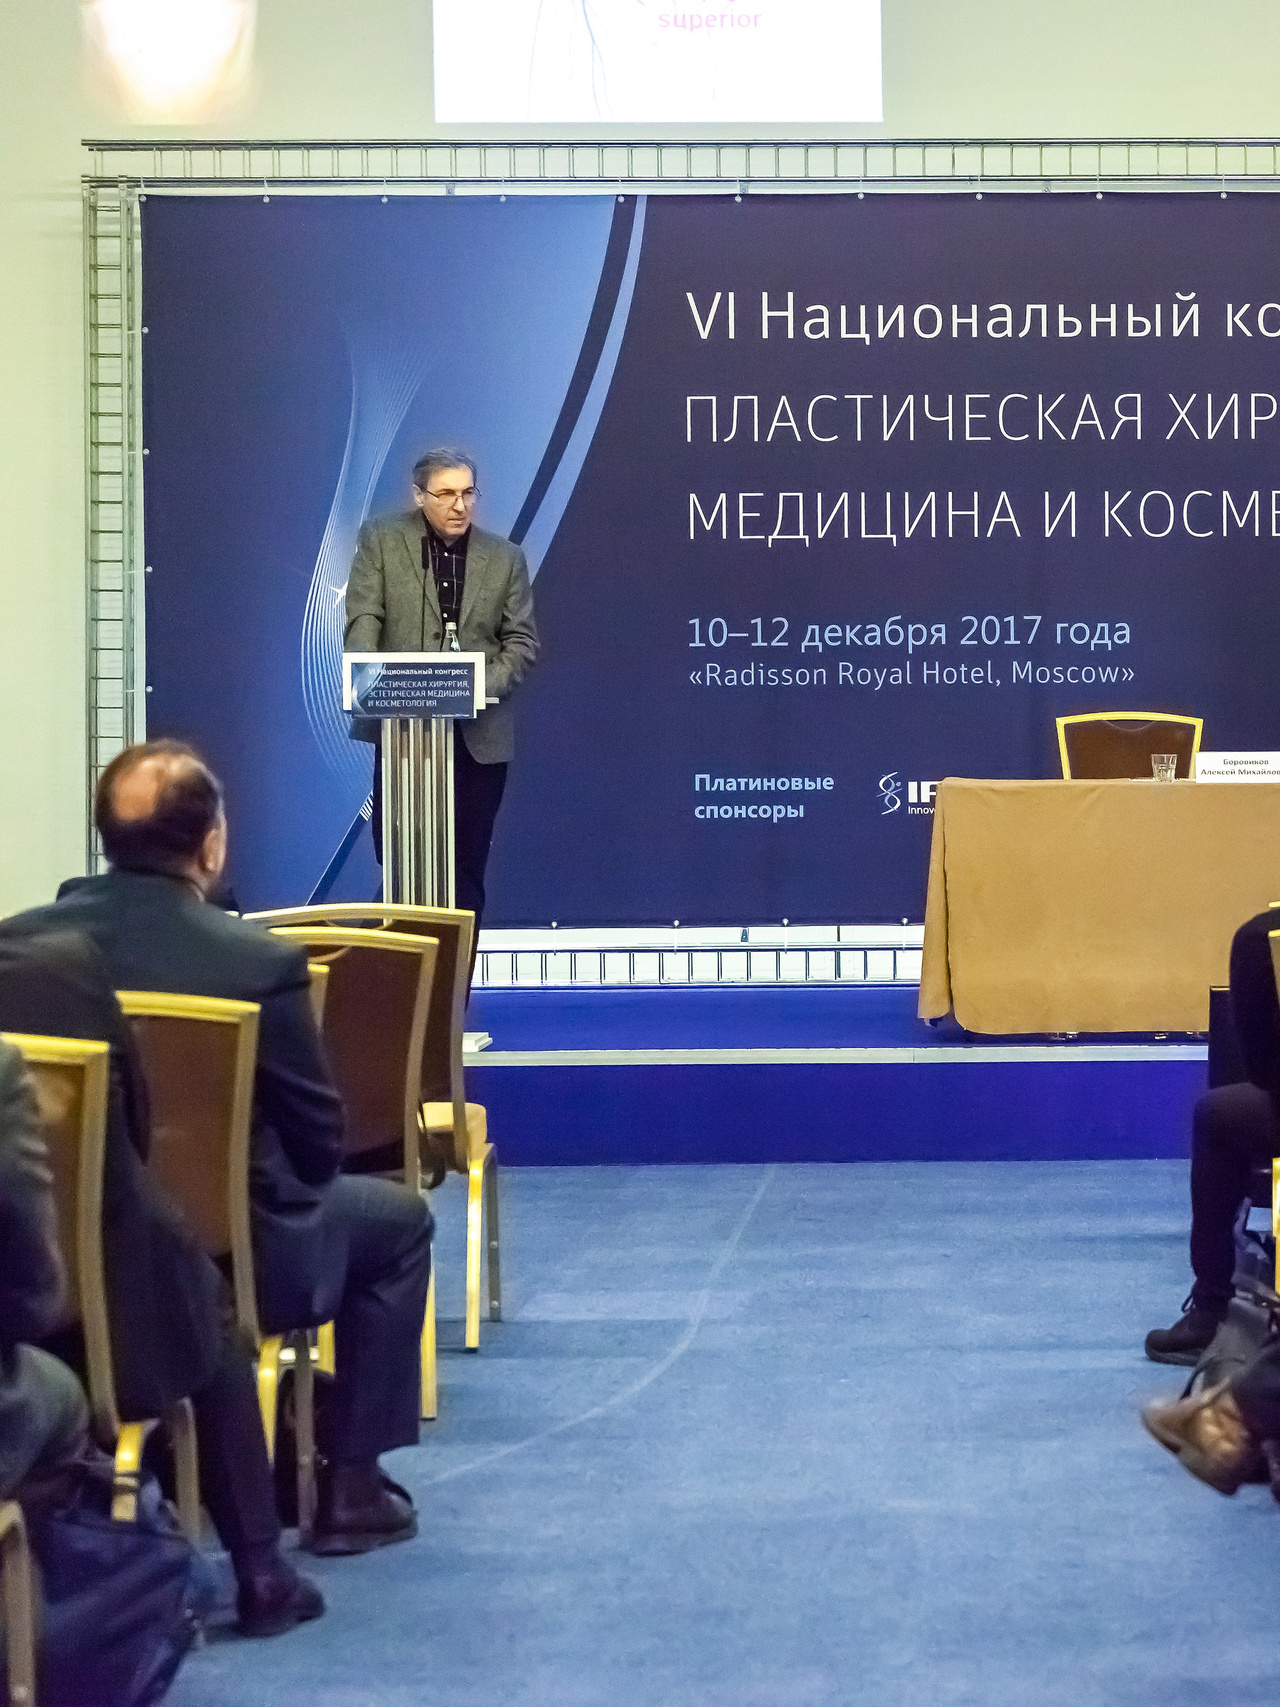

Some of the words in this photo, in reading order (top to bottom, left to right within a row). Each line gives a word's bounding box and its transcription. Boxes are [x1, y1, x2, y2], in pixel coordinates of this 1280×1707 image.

[658, 9, 762, 33] superior
[685, 291, 735, 340] VI
[761, 291, 1199, 346] Национальный
[686, 393, 1142, 443] ПЛАСТИЧЕСКАЯ
[689, 490, 1022, 548] МЕДИЦИНА
[1044, 490, 1076, 538] И
[801, 614, 946, 655] декабря
[960, 615, 1042, 645] 2017
[1056, 622, 1130, 651] года
[434, 668, 469, 676] конгресс
[689, 661, 827, 686] «Radisson
[838, 660, 913, 691] Royal
[923, 660, 1001, 687] Hotel,
[1012, 660, 1135, 684] Moscow»
[367, 699, 375, 707] И
[375, 699, 437, 707] КОСМЕТОЛОГИЯ
[427, 689, 471, 698] МЕДИЦИНА
[1200, 768, 1236, 776] Алексей
[1222, 758, 1270, 767] Боровиков
[694, 773, 835, 792] Платиновые
[694, 804, 804, 824] спонсоры
